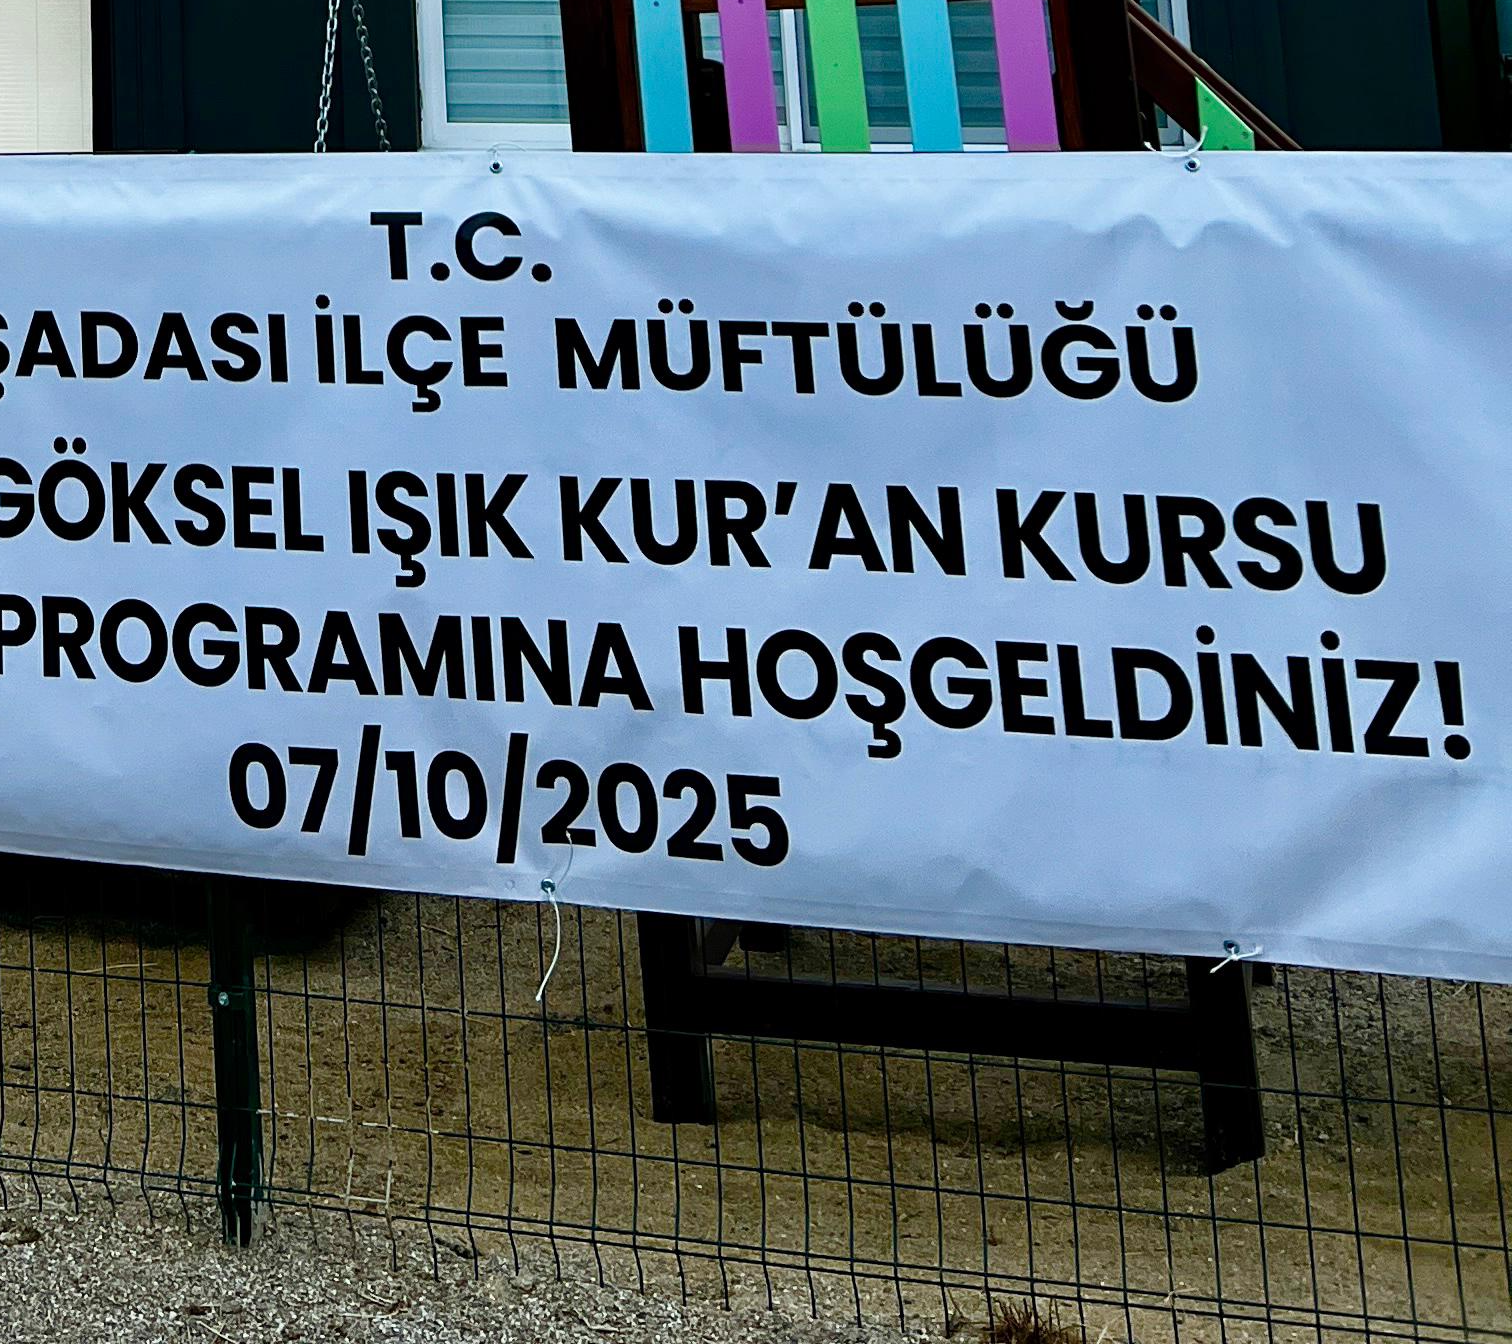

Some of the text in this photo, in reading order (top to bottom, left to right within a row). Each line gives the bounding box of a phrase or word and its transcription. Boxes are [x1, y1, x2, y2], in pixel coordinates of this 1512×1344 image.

[369, 211, 552, 283] T.C.
[314, 294, 509, 413] İLÇE
[554, 298, 1199, 403] MÜFTÜLÜĞÜ
[348, 469, 535, 588] IŞIK
[995, 488, 1388, 595] KURSU
[674, 624, 1473, 762] HOŞGELDİNİZ!
[228, 723, 792, 868] 07/10/2025
